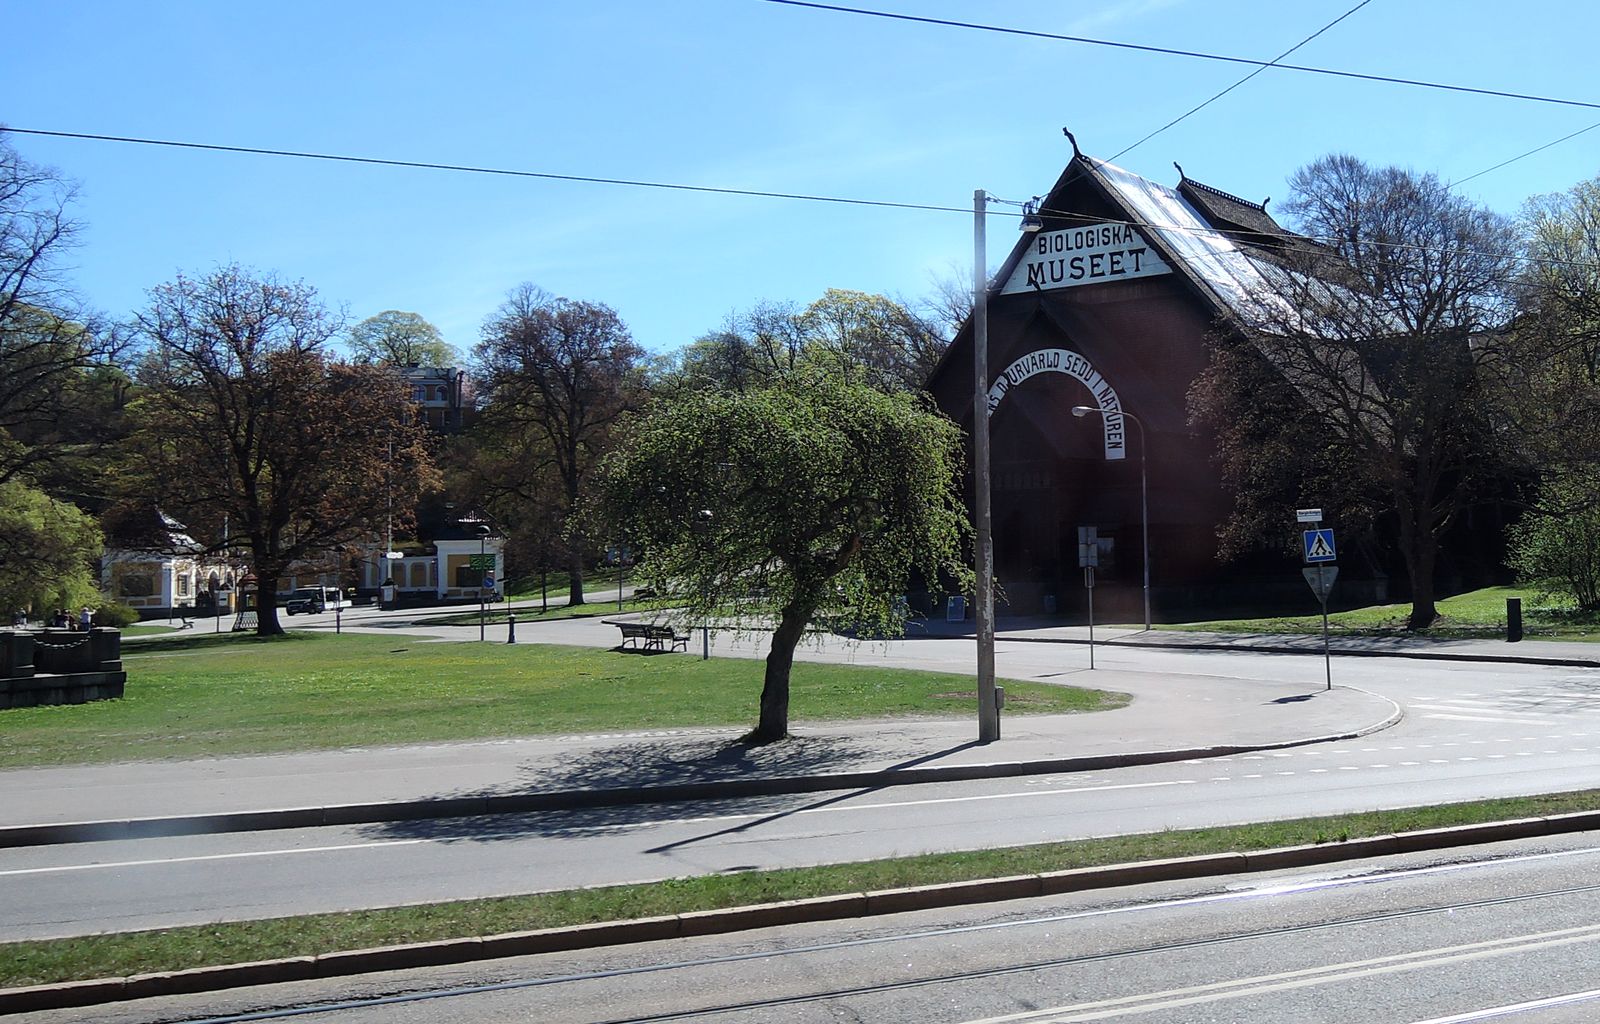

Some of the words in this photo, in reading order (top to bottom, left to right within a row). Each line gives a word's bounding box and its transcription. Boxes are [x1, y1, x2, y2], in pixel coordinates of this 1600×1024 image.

[1038, 225, 1134, 255] BIOLOGISKA
[1026, 247, 1147, 287] MUSEET
[996, 352, 1060, 393] DURVÄRLD
[1064, 354, 1095, 382] SEDD
[1092, 377, 1103, 390] I
[1097, 386, 1123, 449] NATUREN
